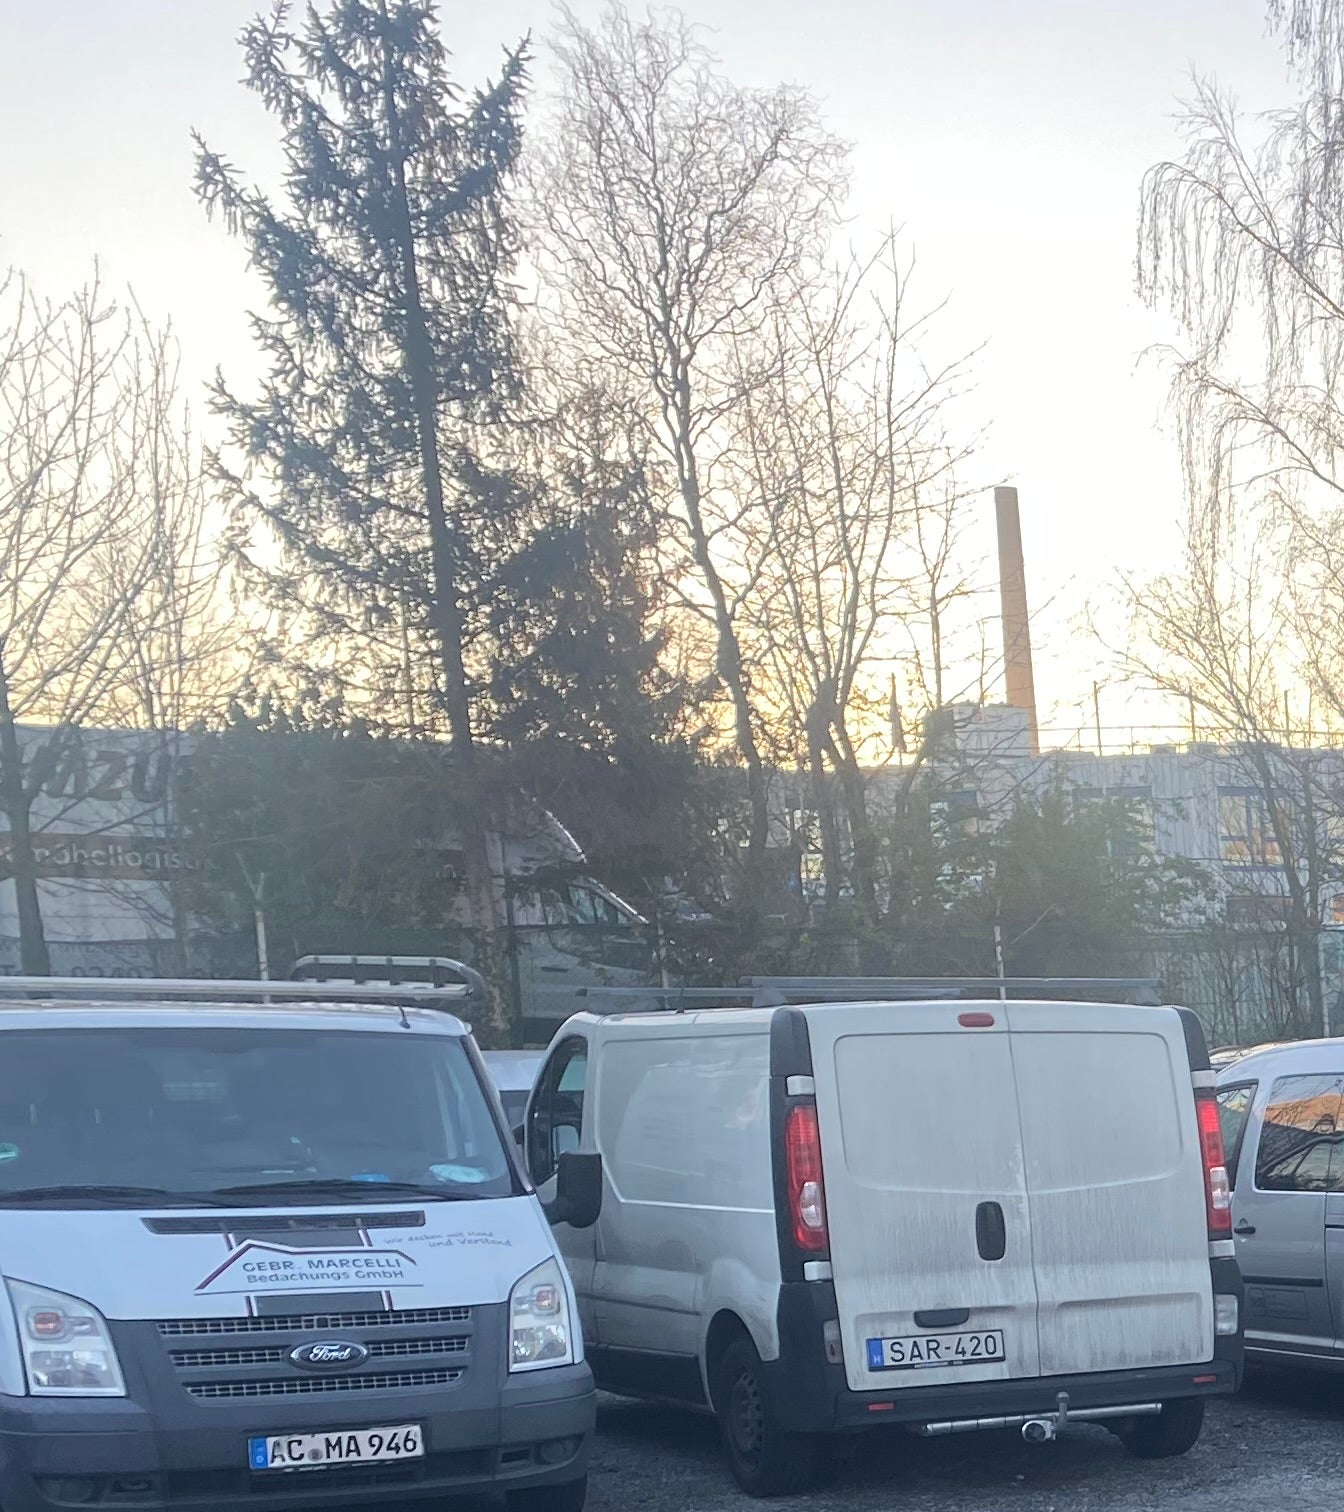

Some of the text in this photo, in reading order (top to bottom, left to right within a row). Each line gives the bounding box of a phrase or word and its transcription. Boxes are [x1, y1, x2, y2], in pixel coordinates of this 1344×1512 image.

[308, 1257, 402, 1269] MARCELLI
[246, 1269, 405, 1284] Bedachungs GmbH
[308, 1343, 352, 1362] Ford
[890, 1334, 997, 1363] SAR-420
[270, 1430, 417, 1464] AC MA 946
